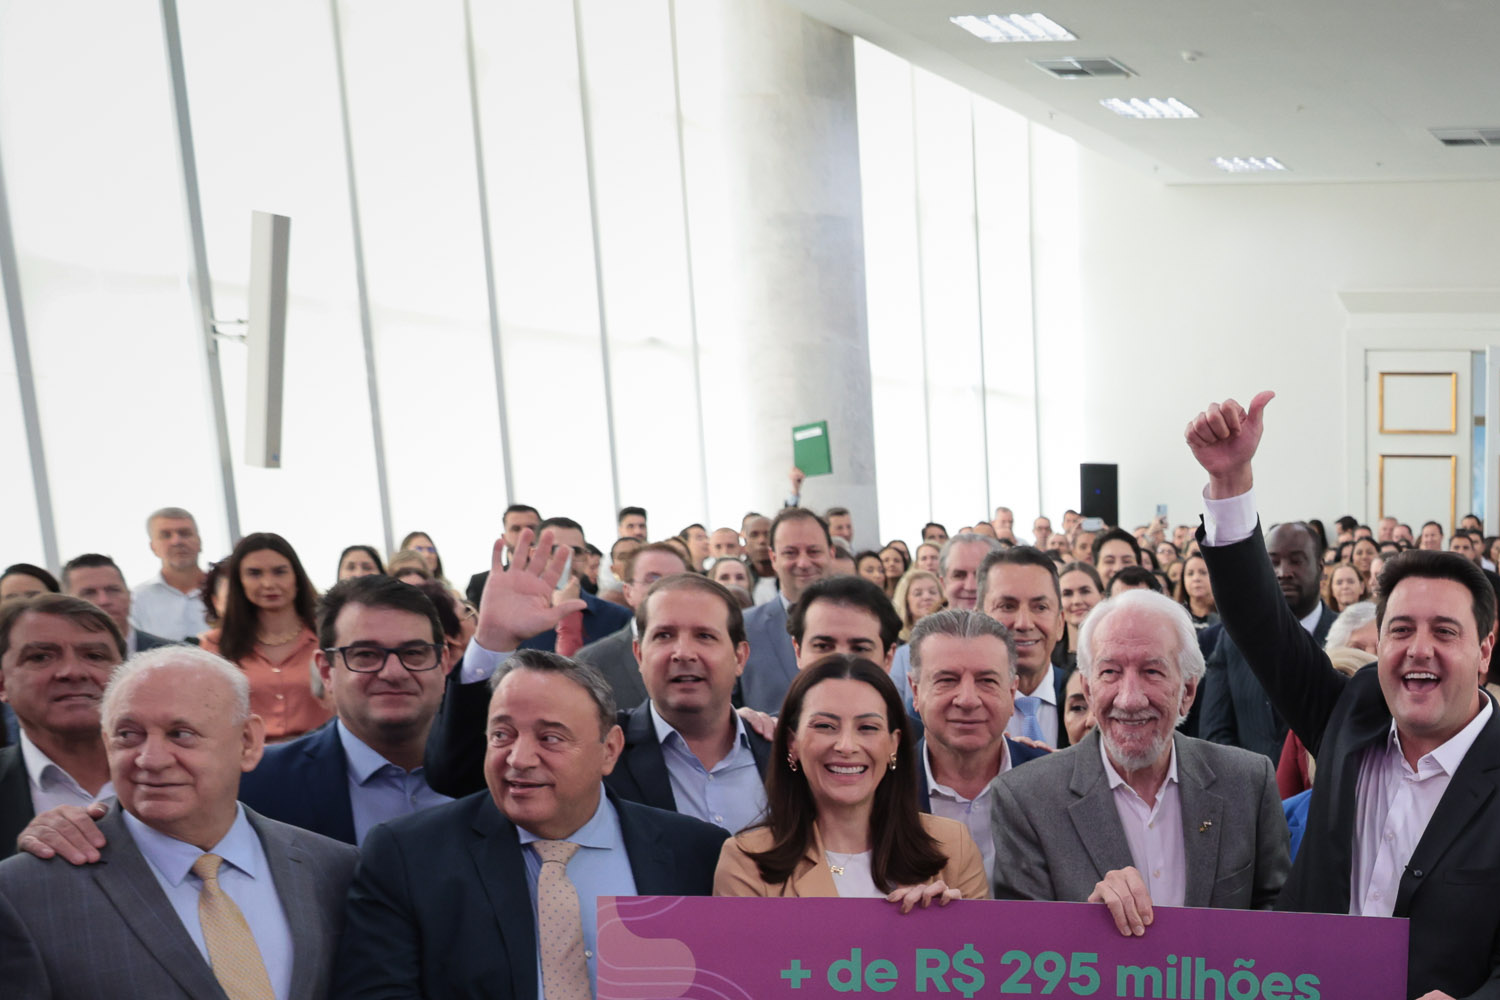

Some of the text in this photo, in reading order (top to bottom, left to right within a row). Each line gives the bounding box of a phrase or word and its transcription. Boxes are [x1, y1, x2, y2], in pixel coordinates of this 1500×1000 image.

[781, 958, 812, 989] +
[827, 946, 898, 993] de
[915, 943, 985, 999] R$
[1000, 949, 1101, 997] 295
